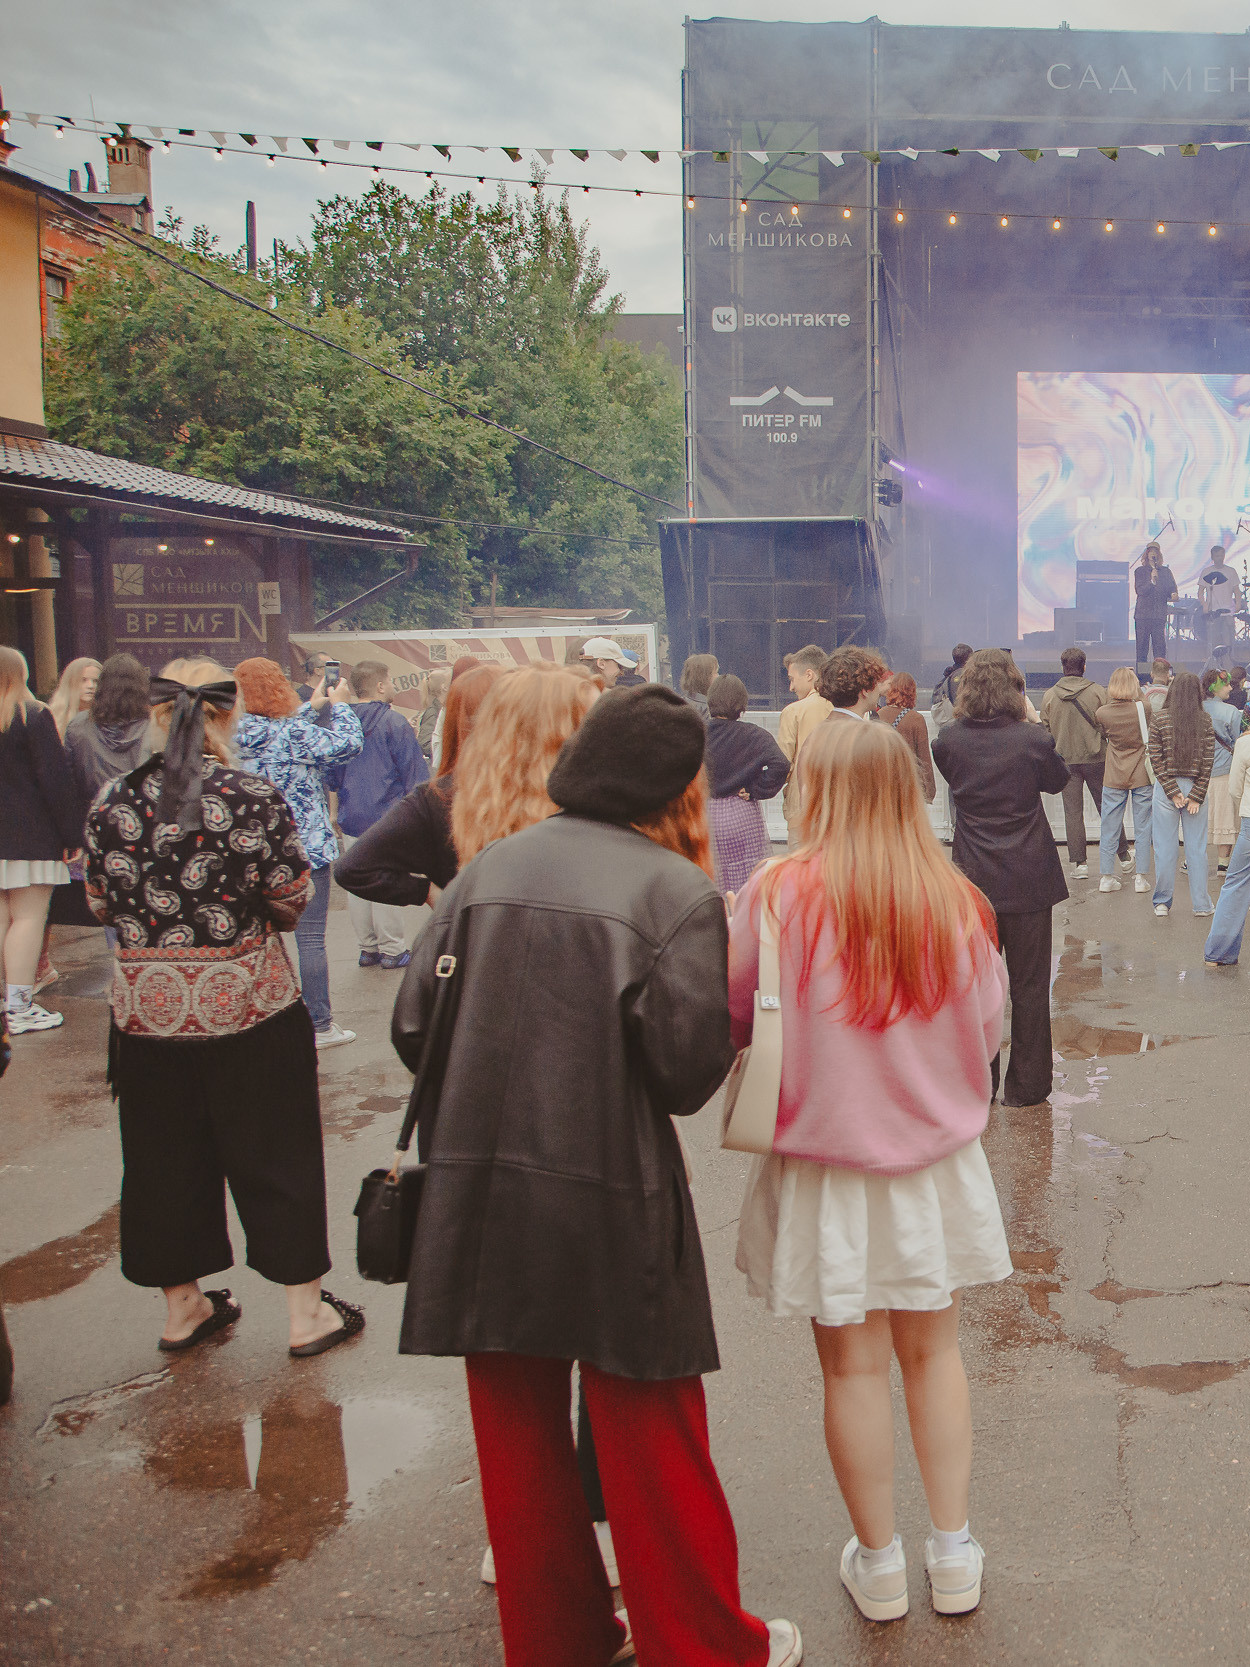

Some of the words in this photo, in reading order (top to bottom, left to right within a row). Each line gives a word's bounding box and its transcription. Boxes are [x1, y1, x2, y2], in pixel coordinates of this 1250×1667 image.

[1046, 63, 1138, 95] САД
[758, 212, 803, 228] САД
[708, 232, 853, 247] МЕНШИКОВА
[742, 414, 795, 428] ПИТЕР
[799, 414, 822, 427] FM
[766, 432, 798, 443] 100.9
[261, 589, 277, 600] WC
